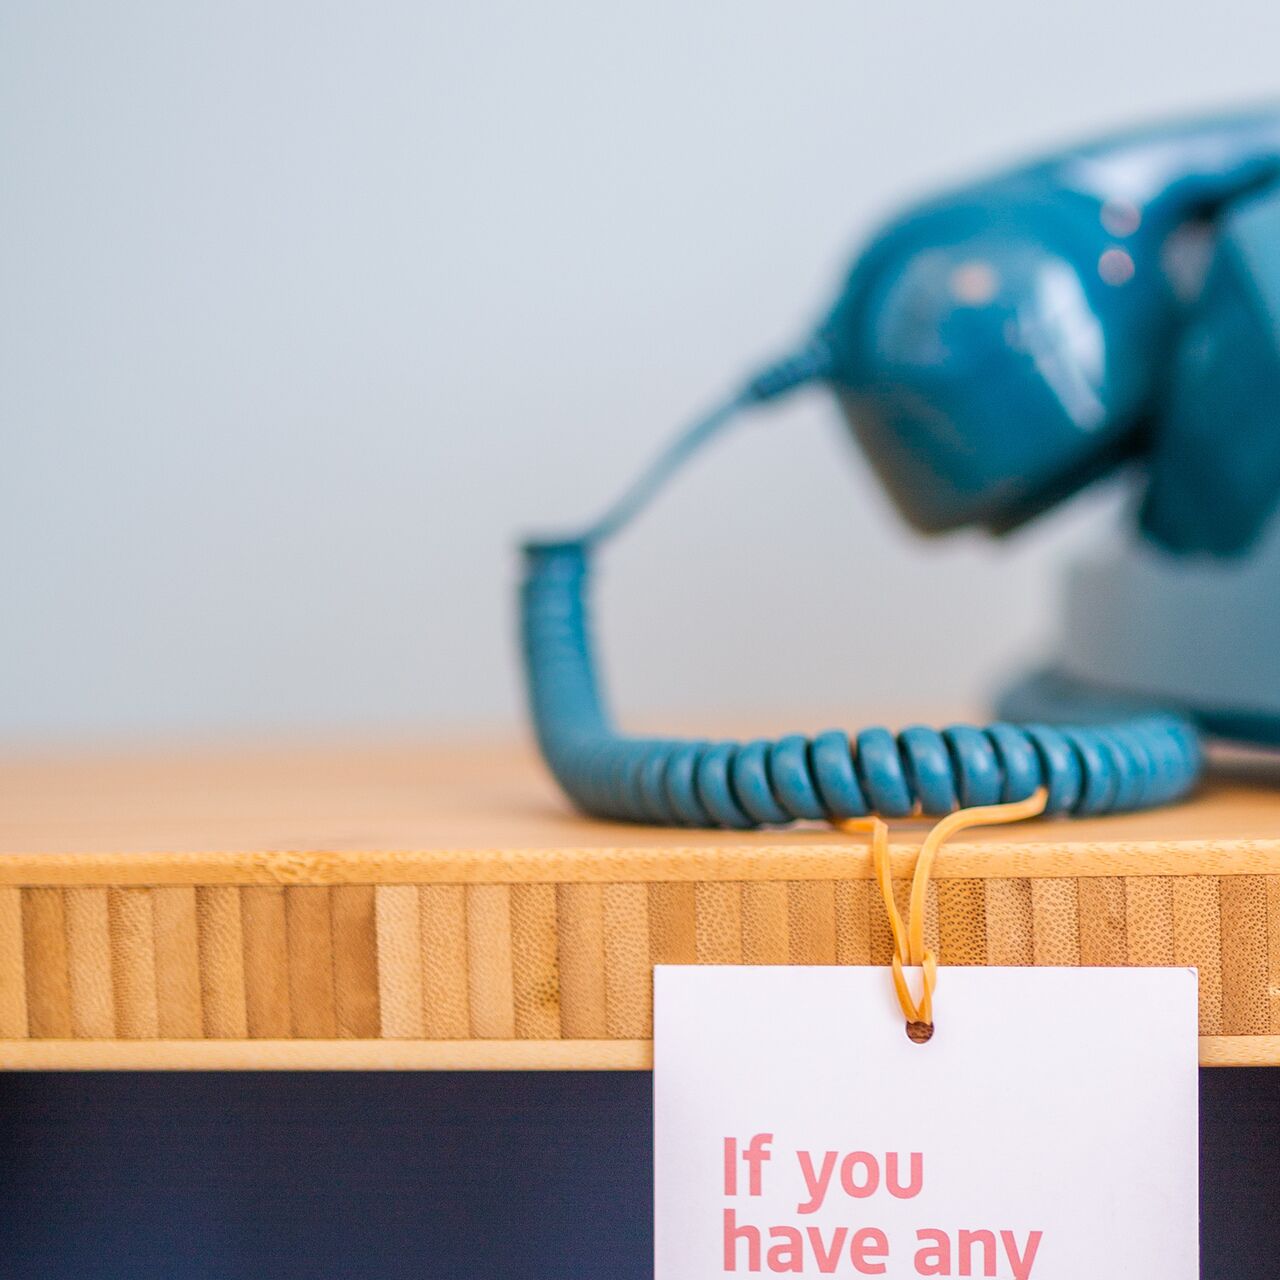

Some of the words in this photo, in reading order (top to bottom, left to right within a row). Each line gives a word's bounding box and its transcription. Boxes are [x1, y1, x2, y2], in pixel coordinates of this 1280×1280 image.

[723, 1133, 774, 1198] If
[795, 1150, 924, 1215] you
[722, 1208, 890, 1276] have
